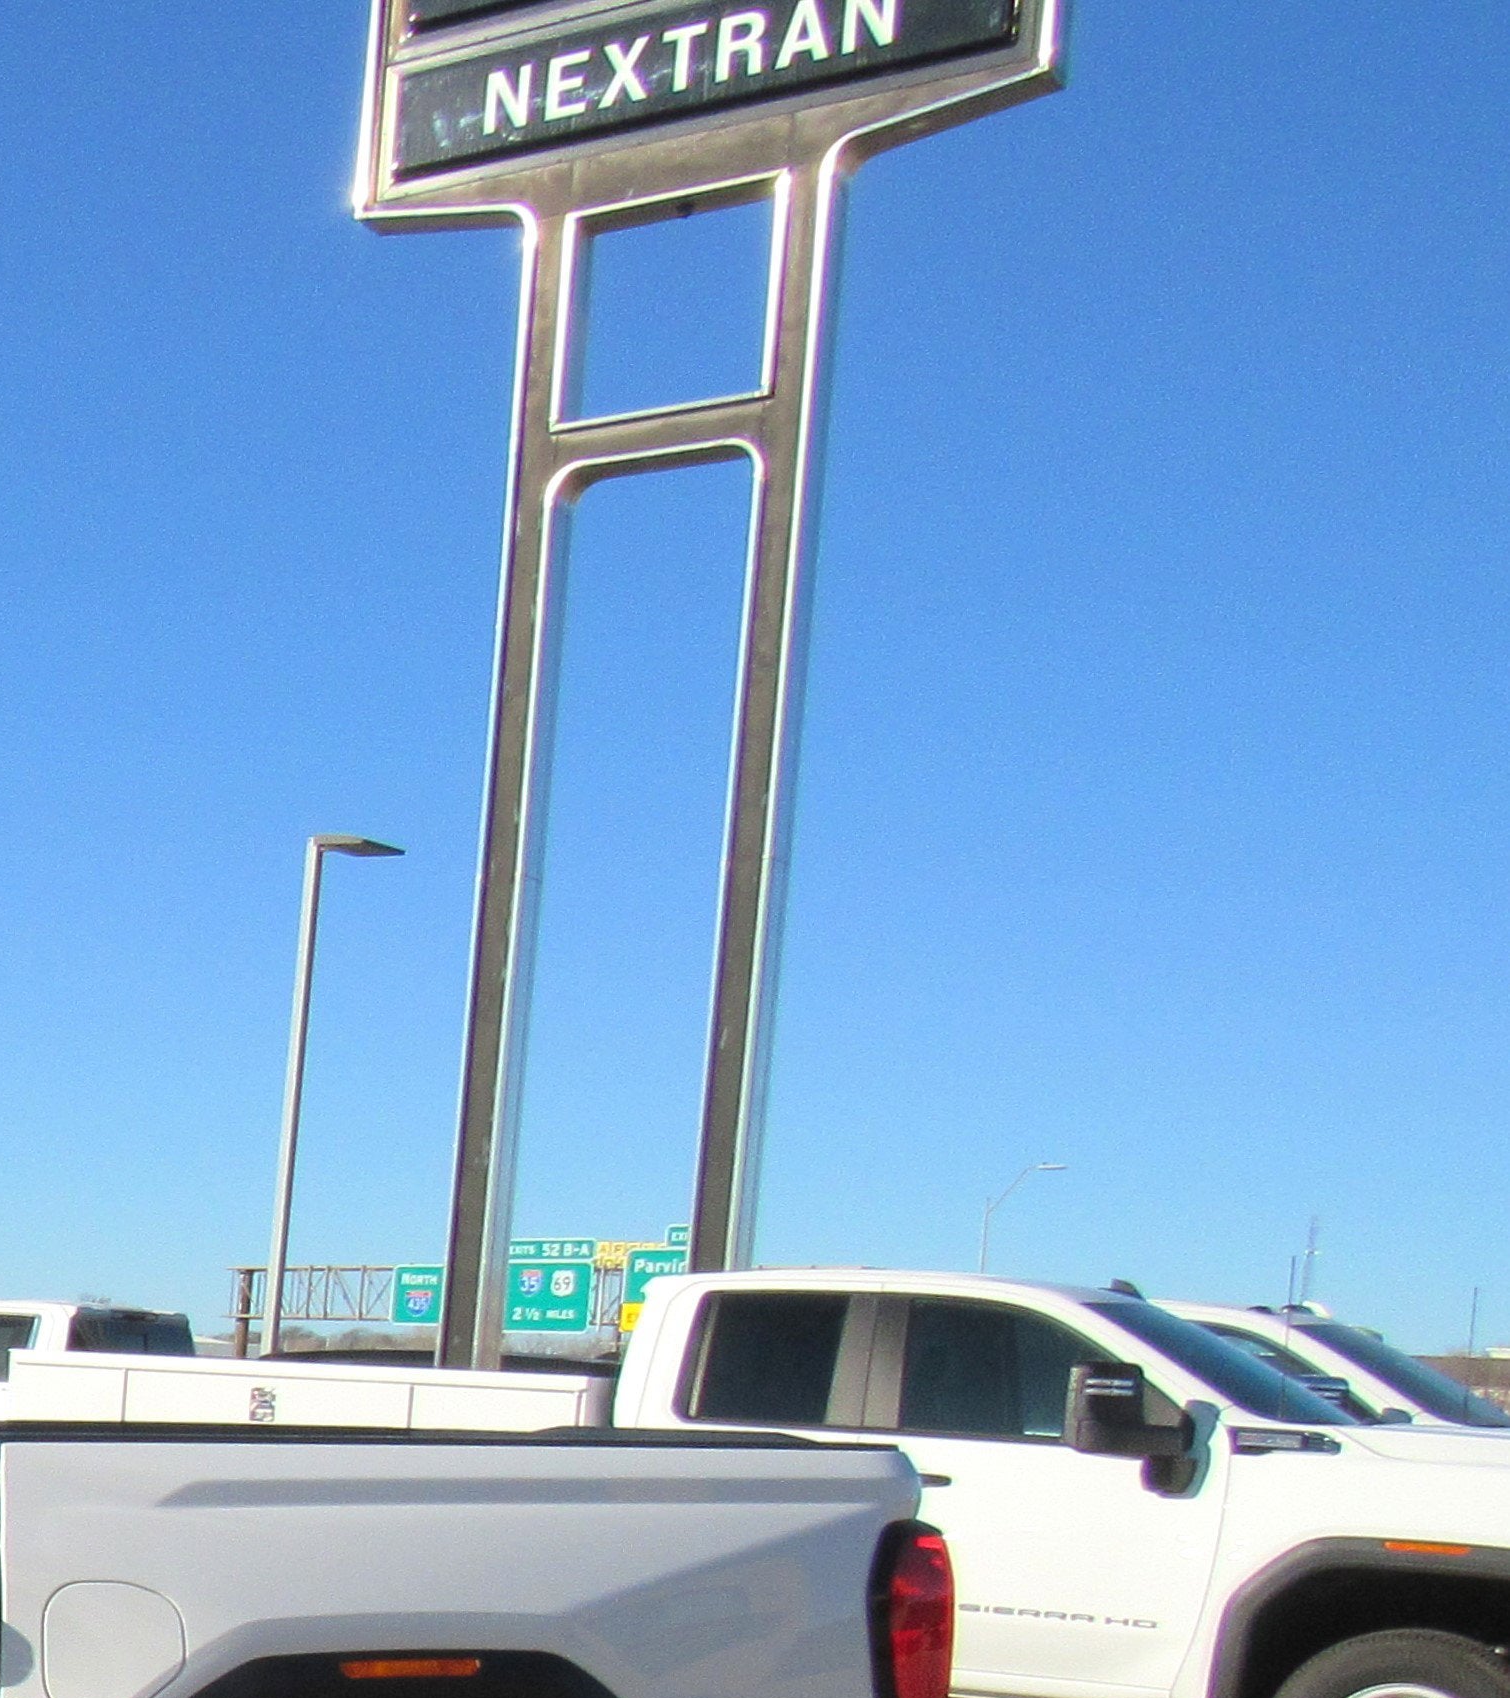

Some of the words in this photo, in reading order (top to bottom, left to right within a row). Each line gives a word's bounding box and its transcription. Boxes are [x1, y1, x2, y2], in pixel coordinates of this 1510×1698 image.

[482, 0, 899, 136] NEXTRAN
[542, 1243, 560, 1257] 52
[563, 1243, 590, 1256] B-A
[400, 1273, 438, 1286] NORTH
[520, 1277, 539, 1291] 35
[554, 1276, 571, 1291] 69
[958, 1603, 1095, 1623] SIERRA
[1104, 1616, 1158, 1629] HD
